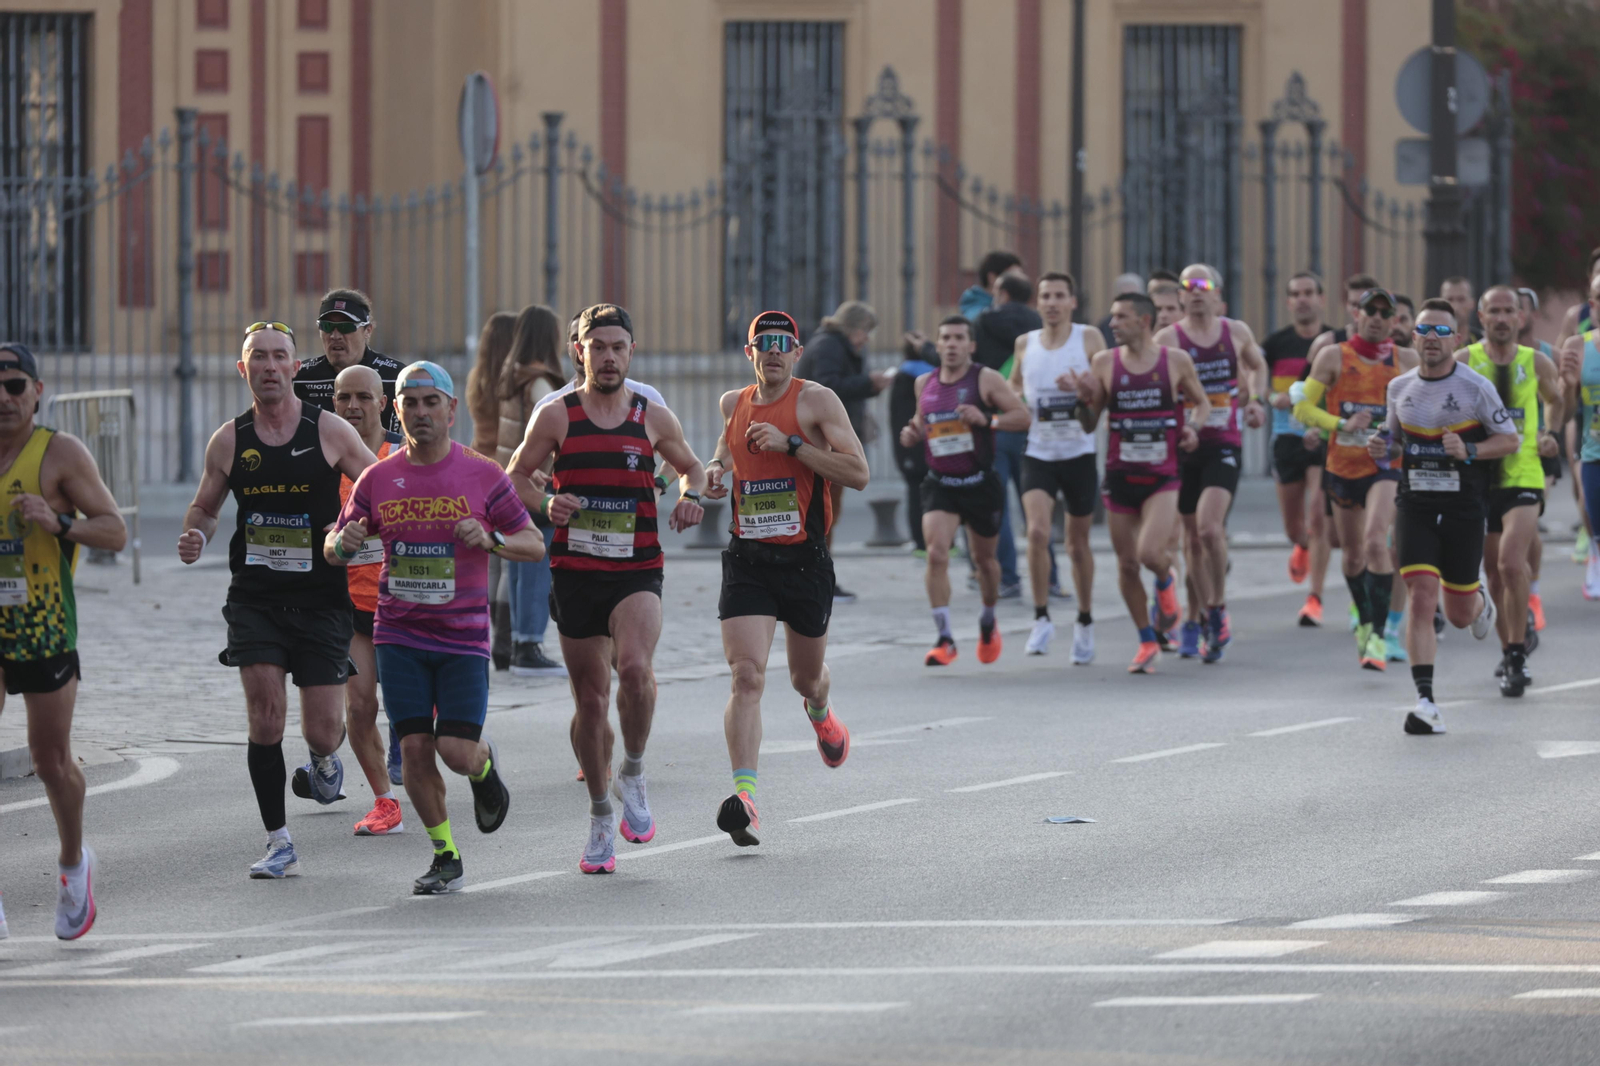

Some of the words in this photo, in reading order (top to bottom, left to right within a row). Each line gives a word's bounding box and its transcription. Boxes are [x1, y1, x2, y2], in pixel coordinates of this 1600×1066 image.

[1420, 446, 1445, 454] ZURIC
[243, 485, 286, 495] EAGLE
[289, 484, 310, 493] AC
[752, 481, 788, 493] ZURICH
[591, 500, 629, 510] ZURICH
[754, 500, 776, 511] 1208
[266, 516, 303, 526] ZURICH
[592, 518, 612, 529] 1421
[757, 514, 791, 524] BARCELO
[269, 534, 285, 543] 921
[591, 533, 610, 543] PAUL
[407, 545, 446, 555] ZURICH
[408, 565, 430, 576] 1531
[395, 579, 447, 590] MARIOYCARLA
